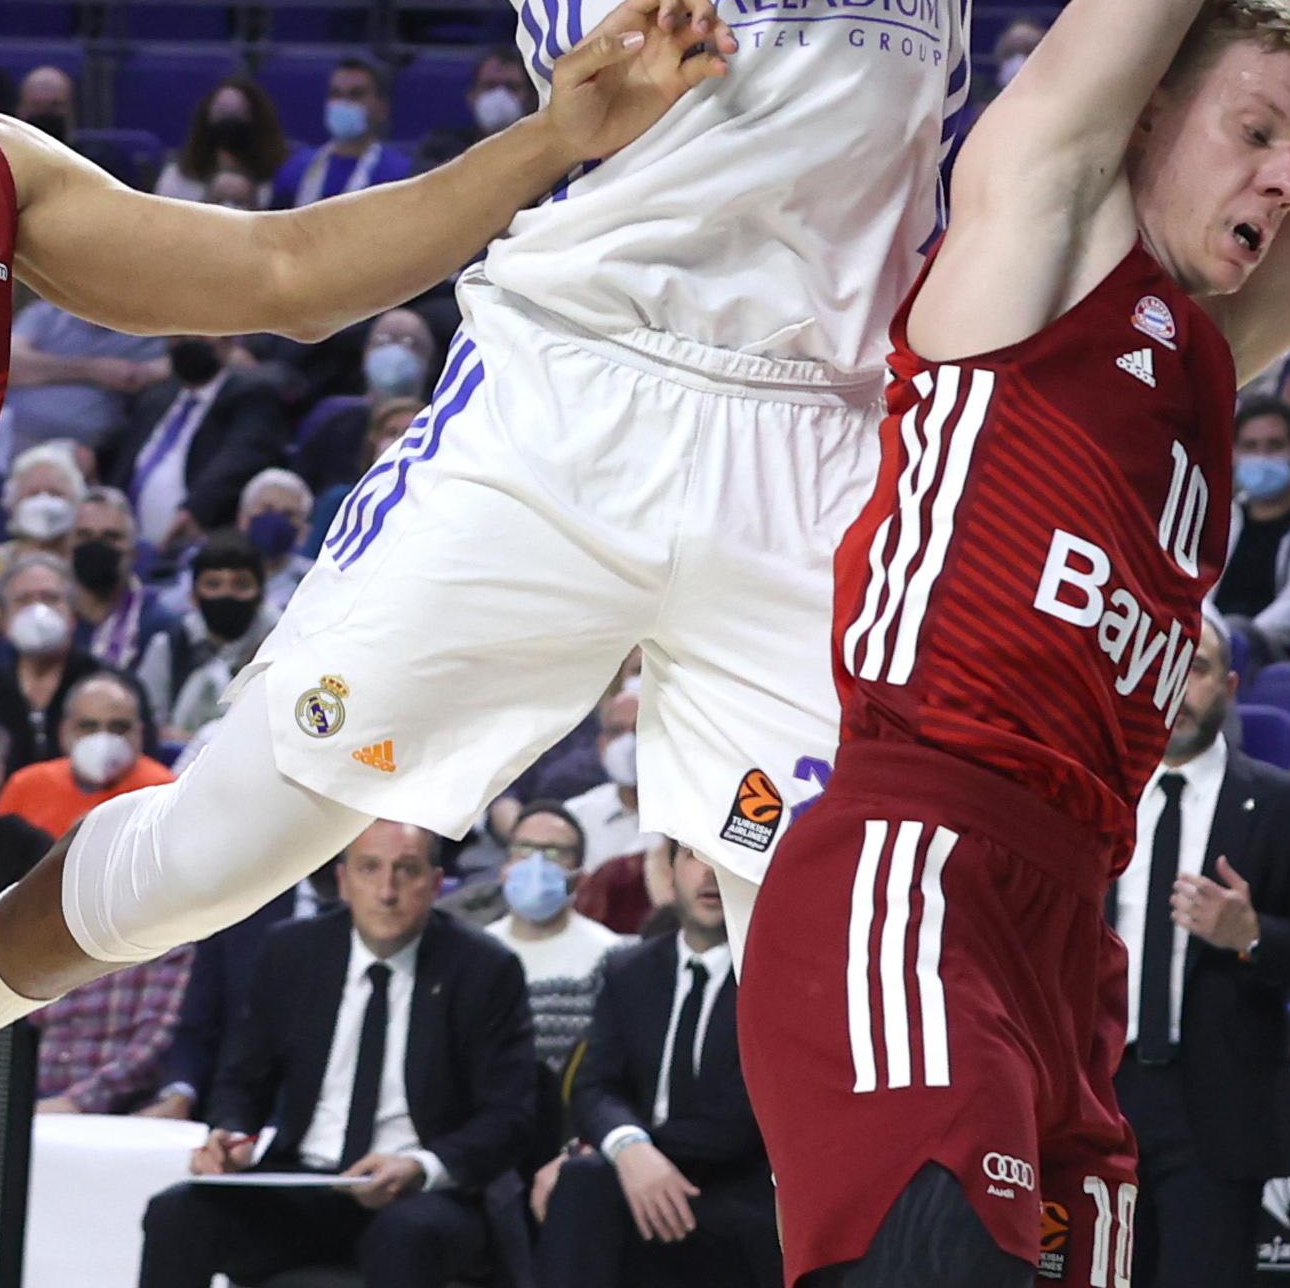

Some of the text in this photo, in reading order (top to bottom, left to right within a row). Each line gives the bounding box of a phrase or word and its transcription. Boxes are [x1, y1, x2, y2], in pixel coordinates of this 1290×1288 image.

[733, 28, 942, 66] TEL GROUP
[1116, 357, 1157, 388] adidas
[1158, 440, 1208, 578] 10
[987, 1184, 1015, 1200] Audi
[1083, 1176, 1138, 1288] 10
